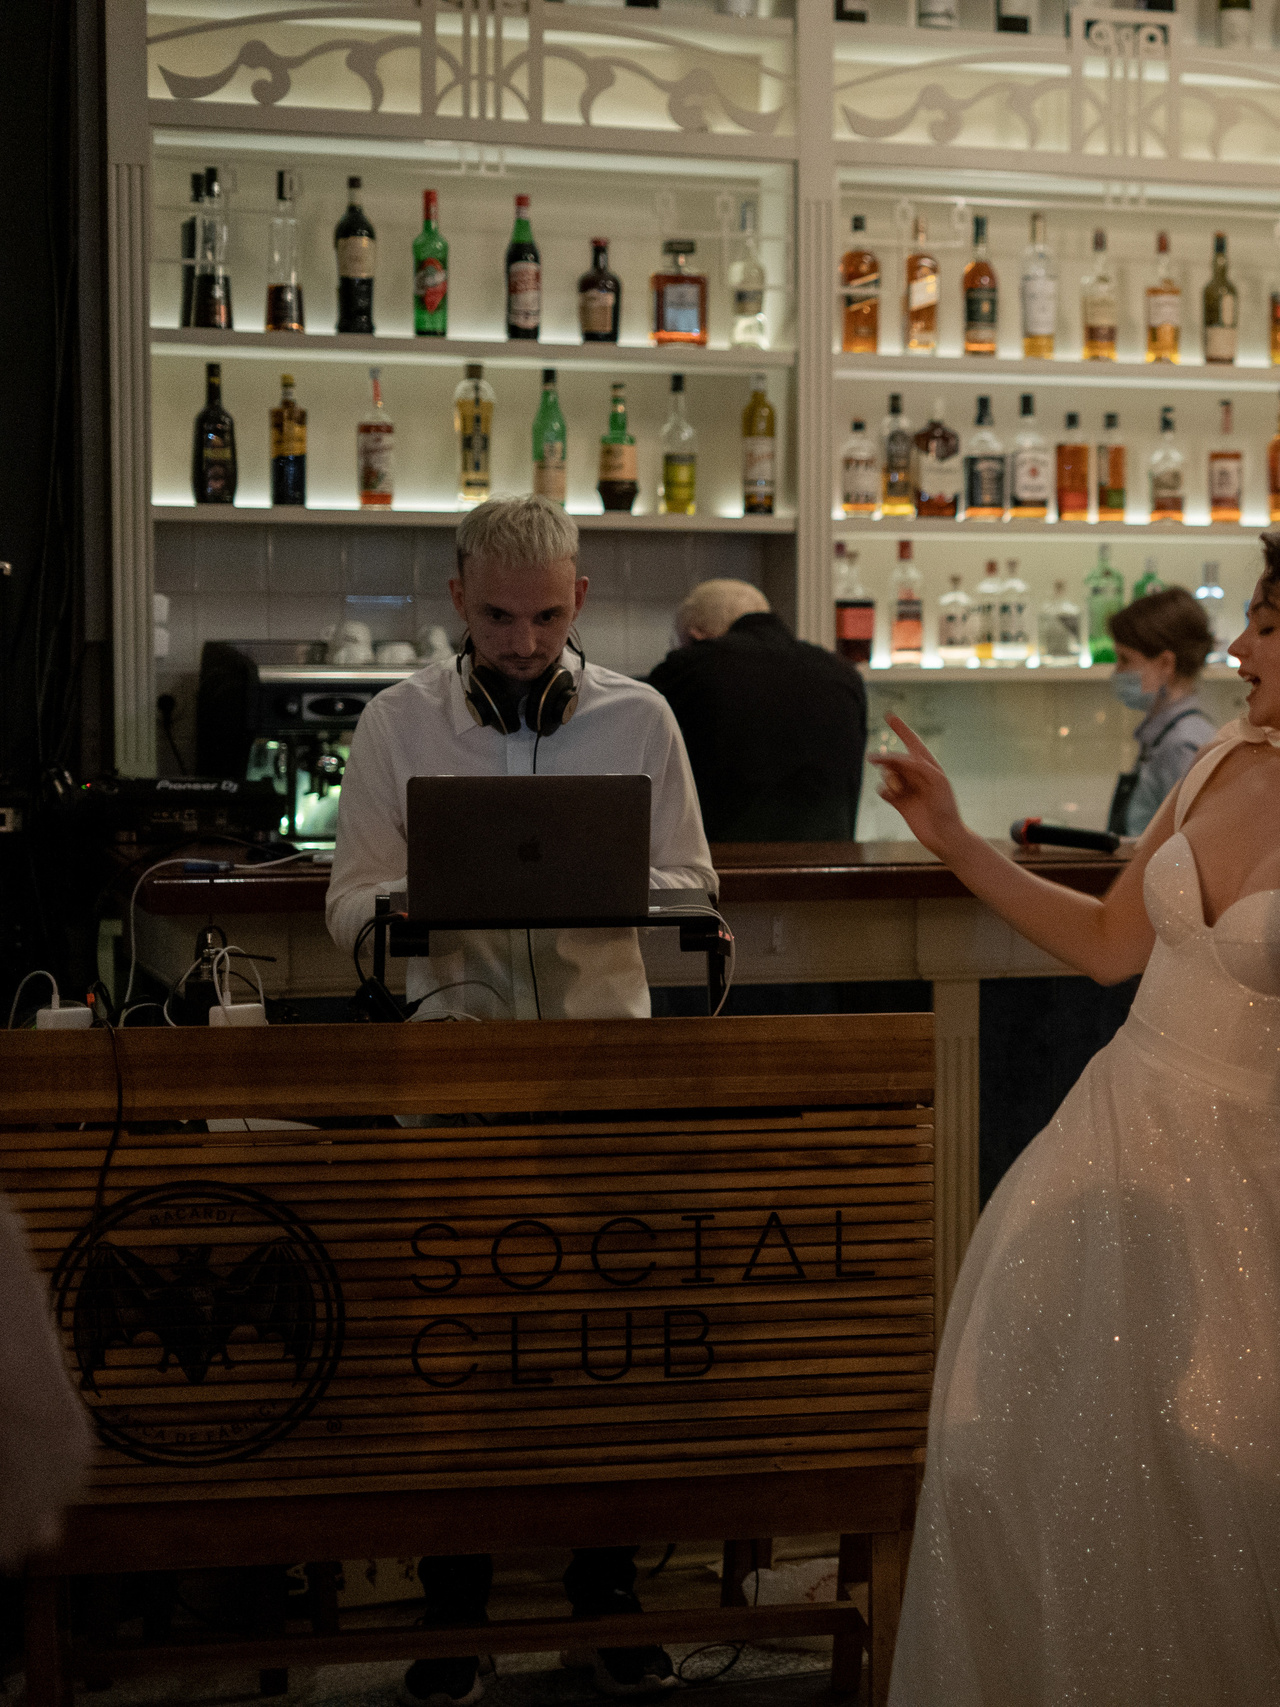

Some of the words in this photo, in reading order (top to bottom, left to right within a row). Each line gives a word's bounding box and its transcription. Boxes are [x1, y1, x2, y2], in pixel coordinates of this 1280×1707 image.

[156, 779, 218, 791] Pioneer
[411, 1210, 875, 1293] SOCIAL
[412, 1309, 714, 1388] CLUB
[206, 1401, 277, 1441] FABCA
